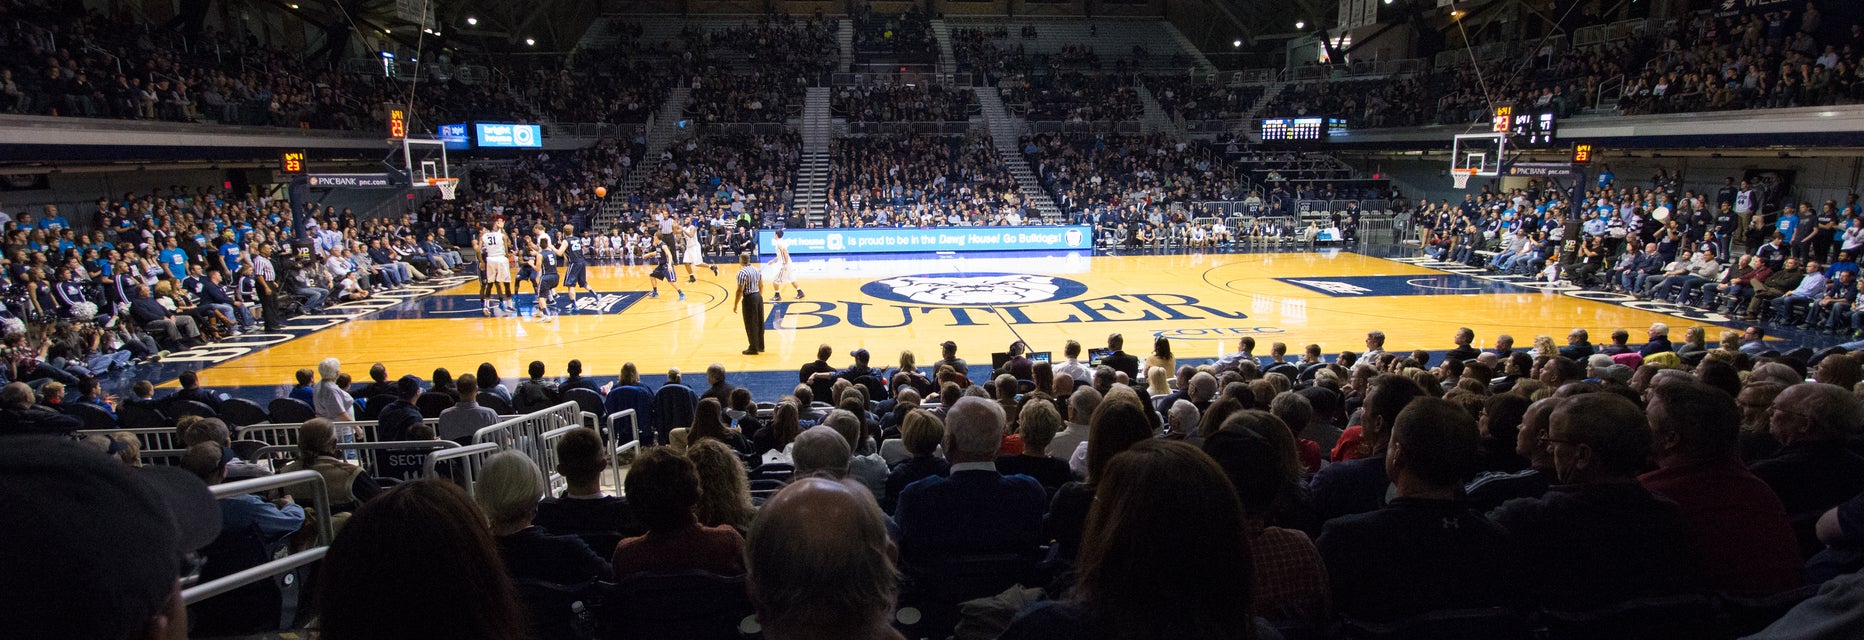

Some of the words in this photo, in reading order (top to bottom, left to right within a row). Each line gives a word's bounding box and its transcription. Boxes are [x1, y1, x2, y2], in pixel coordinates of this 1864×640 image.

[391, 120, 404, 137] 23
[1495, 116, 1509, 131] 23
[1540, 121, 1550, 130] 47
[1576, 152, 1587, 161] 23
[287, 161, 300, 171] 23
[487, 236, 497, 246] 31
[848, 236, 857, 245] is
[858, 234, 884, 247] proud
[885, 234, 895, 245] to
[897, 234, 909, 245] be
[911, 233, 920, 244] in
[921, 234, 936, 245] the
[939, 234, 965, 246] Dawg
[968, 233, 1001, 244] House!
[1003, 233, 1017, 244] Go
[1018, 232, 1061, 245] Bulldogs!
[547, 253, 555, 265] 5
[763, 293, 1248, 331] BUTLER
